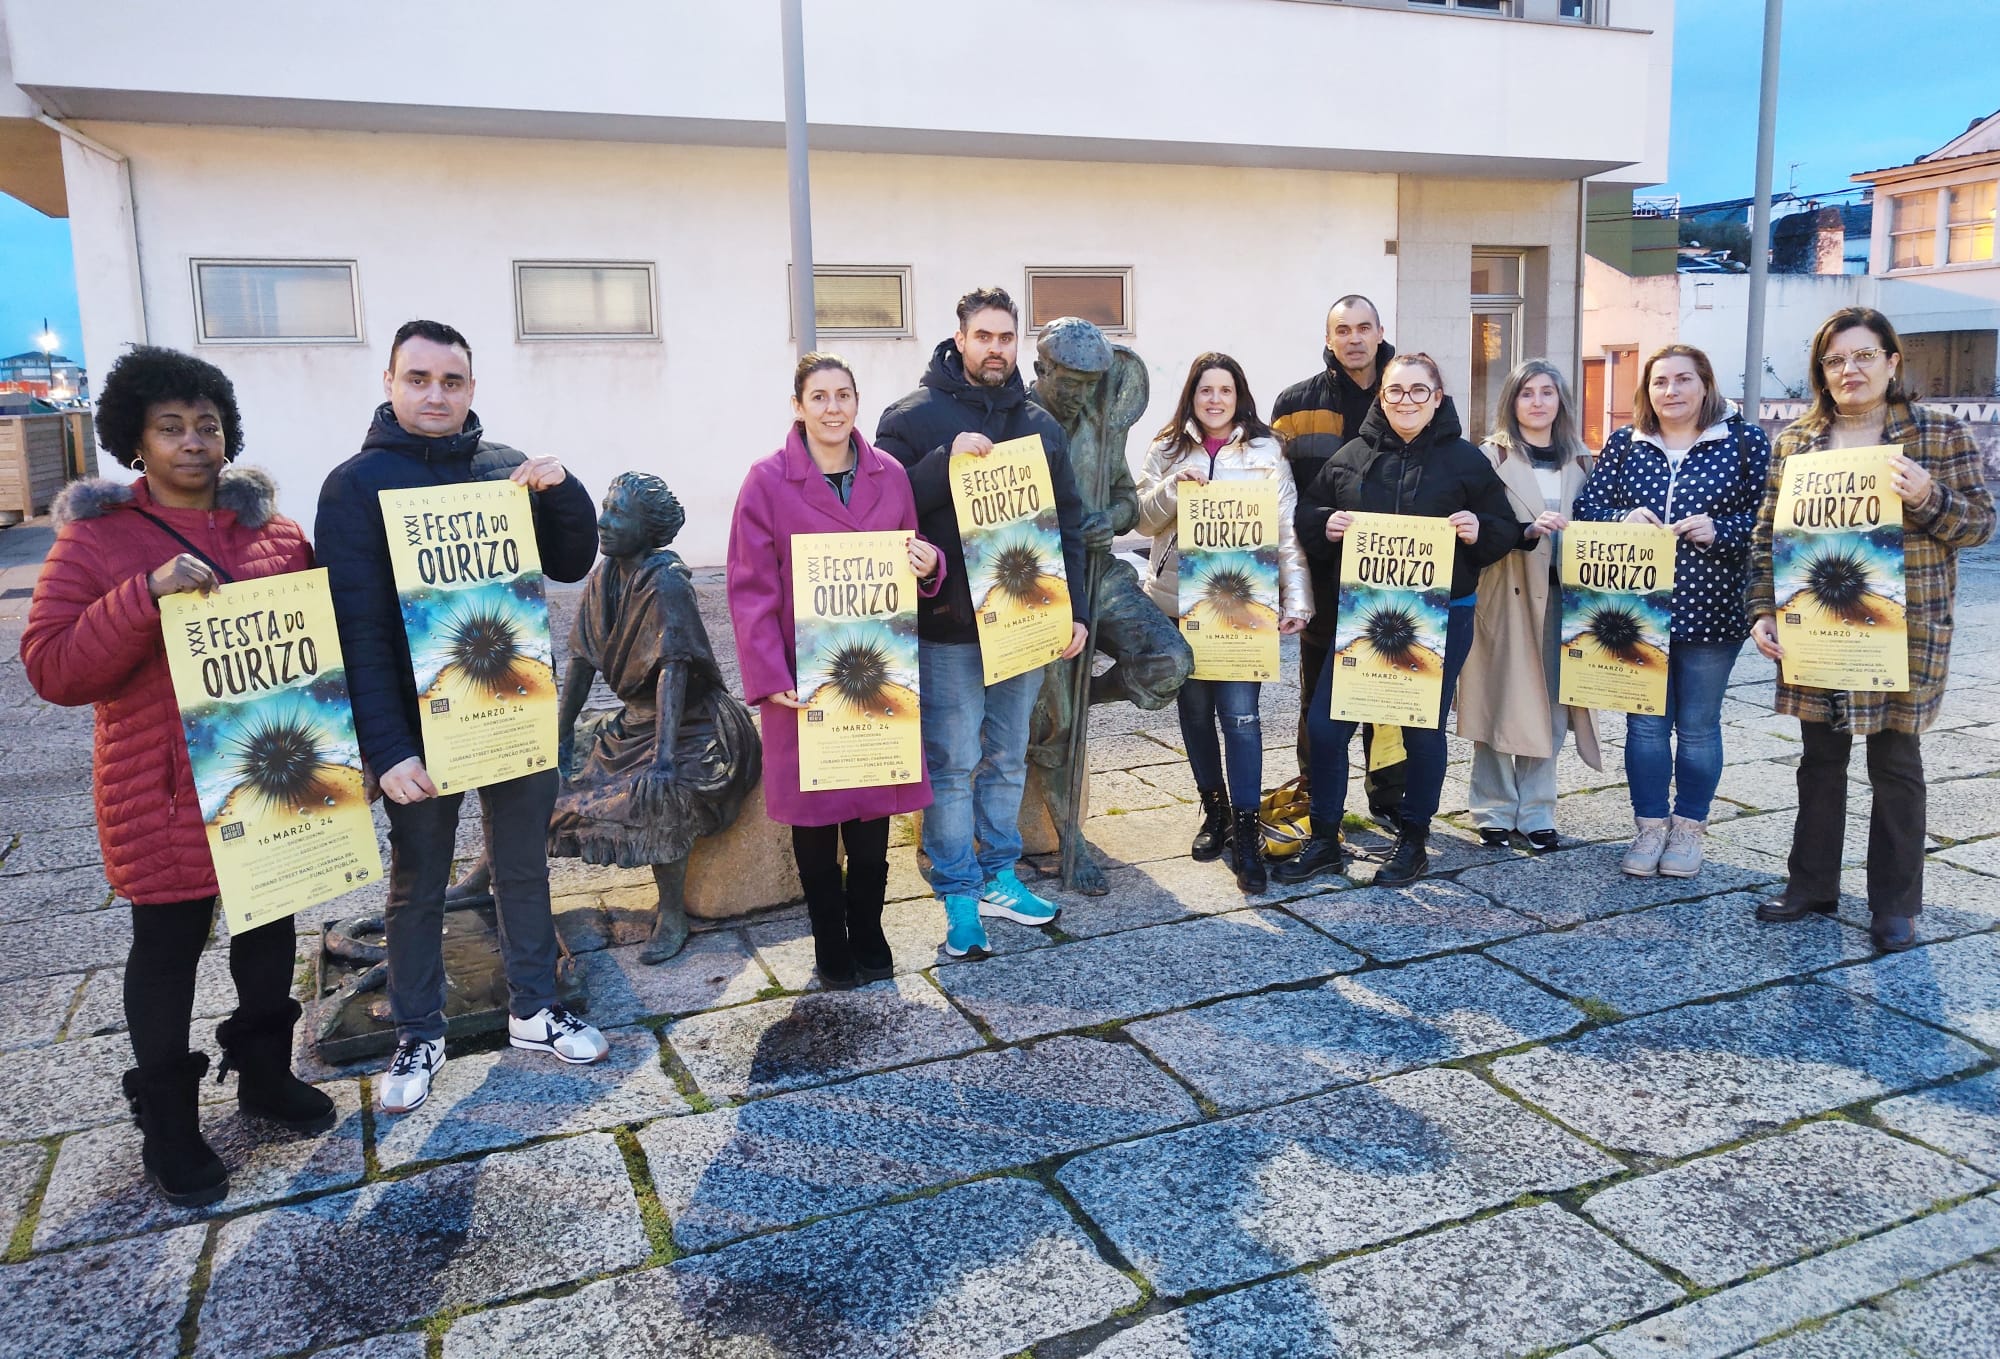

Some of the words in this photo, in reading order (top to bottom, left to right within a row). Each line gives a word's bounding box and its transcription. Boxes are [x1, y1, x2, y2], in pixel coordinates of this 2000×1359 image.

[962, 473, 974, 497] XXXI
[973, 464, 1018, 493] FESTA
[1018, 465, 1031, 481] DO
[1792, 473, 1804, 497] XXXI
[1806, 471, 1855, 495] FESTA
[1860, 475, 1876, 491] DO
[394, 497, 429, 509] SAN
[971, 484, 1039, 526] OURIZO
[1190, 499, 1199, 520] XXXI
[1202, 499, 1244, 520] FESTA
[1247, 504, 1259, 517] DO
[1793, 495, 1881, 529] OURIZO
[404, 515, 422, 546] XXXI
[422, 511, 488, 543] FESTA
[490, 514, 509, 535] DO
[1194, 521, 1263, 548] OURIZO
[1356, 531, 1368, 554] XXXI
[1370, 532, 1415, 558] FESTA
[1419, 542, 1433, 556] DO
[1576, 540, 1586, 560] XXXI
[1590, 540, 1636, 563] FESTA
[1640, 548, 1654, 561] DO
[417, 538, 520, 584] OURIZO
[808, 557, 820, 583] XXXI
[823, 555, 875, 582] FESTA
[879, 561, 893, 577] DO
[1358, 556, 1435, 587] OURIZO
[1579, 563, 1657, 590] OURIZO
[176, 600, 214, 615] SAN
[814, 582, 899, 617] OURIZO
[185, 622, 207, 657] XXXI
[207, 610, 281, 650] FESTA
[284, 611, 305, 632] DO
[202, 637, 318, 698] OURIZO
[472, 707, 505, 720] MARZO
[513, 704, 524, 713] 24
[258, 837, 269, 845] 16
[273, 822, 311, 841] MARZO
[321, 816, 333, 826] 24
